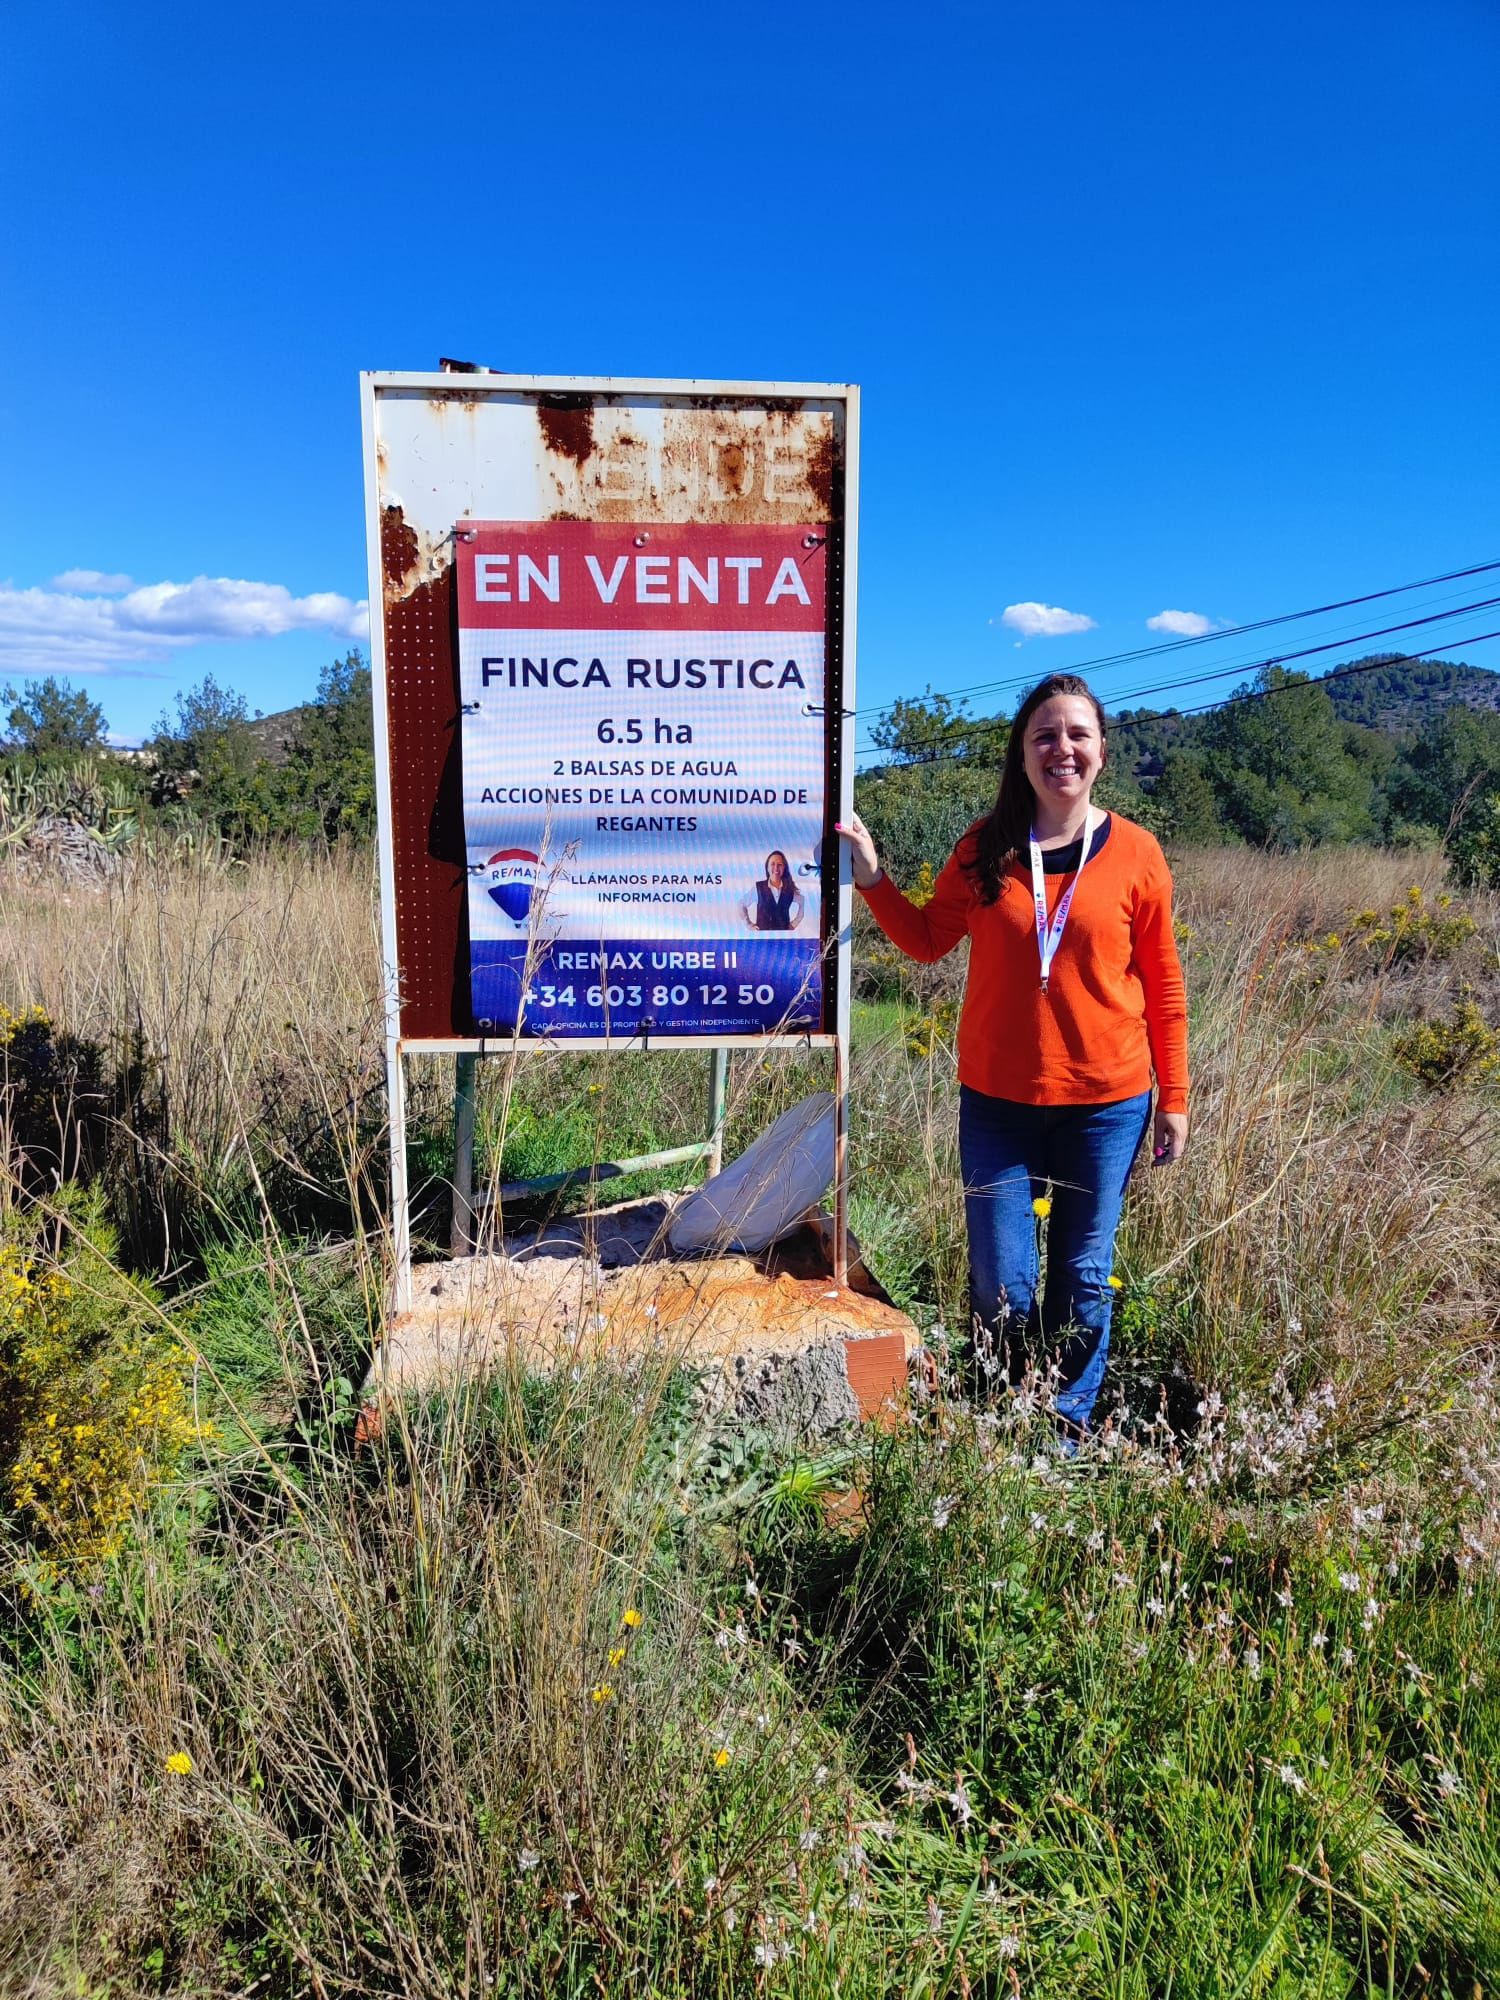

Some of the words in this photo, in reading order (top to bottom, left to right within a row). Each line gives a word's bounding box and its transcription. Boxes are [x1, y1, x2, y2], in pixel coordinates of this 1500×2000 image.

[474, 554, 560, 603] EN
[585, 555, 812, 605] VENTA
[481, 657, 612, 688] FINCA
[627, 658, 805, 689] RUSTICA
[597, 718, 643, 744] 6.5
[654, 717, 692, 744] ha
[553, 760, 565, 776] 2
[571, 760, 644, 776] BALSAS
[651, 760, 676, 776] DE
[681, 761, 738, 777] AGUA
[480, 787, 583, 804] ACCIONES
[589, 788, 614, 804] DE
[620, 788, 645, 804] LA
[650, 788, 777, 804] COMUNIDAD
[783, 788, 808, 804] DE
[596, 816, 698, 832] REGANTES
[571, 871, 648, 885] LLÁMANOS
[652, 874, 689, 885] PARA
[693, 872, 722, 885] MÁS
[598, 892, 696, 903] INFORMACION
[558, 952, 644, 970] REMAX
[651, 952, 716, 970] URBE
[723, 951, 737, 969] II
[525, 985, 577, 1008] +34
[586, 985, 642, 1007] 603
[652, 985, 689, 1006] 80
[699, 984, 727, 1005] 12
[738, 984, 774, 1005] 50
[555, 1021, 588, 1030] OFICINA
[589, 1021, 599, 1029] ES
[659, 1020, 665, 1028] Y
[666, 1019, 699, 1028] GESTION
[700, 1018, 760, 1027] INDEPENDIENTE
